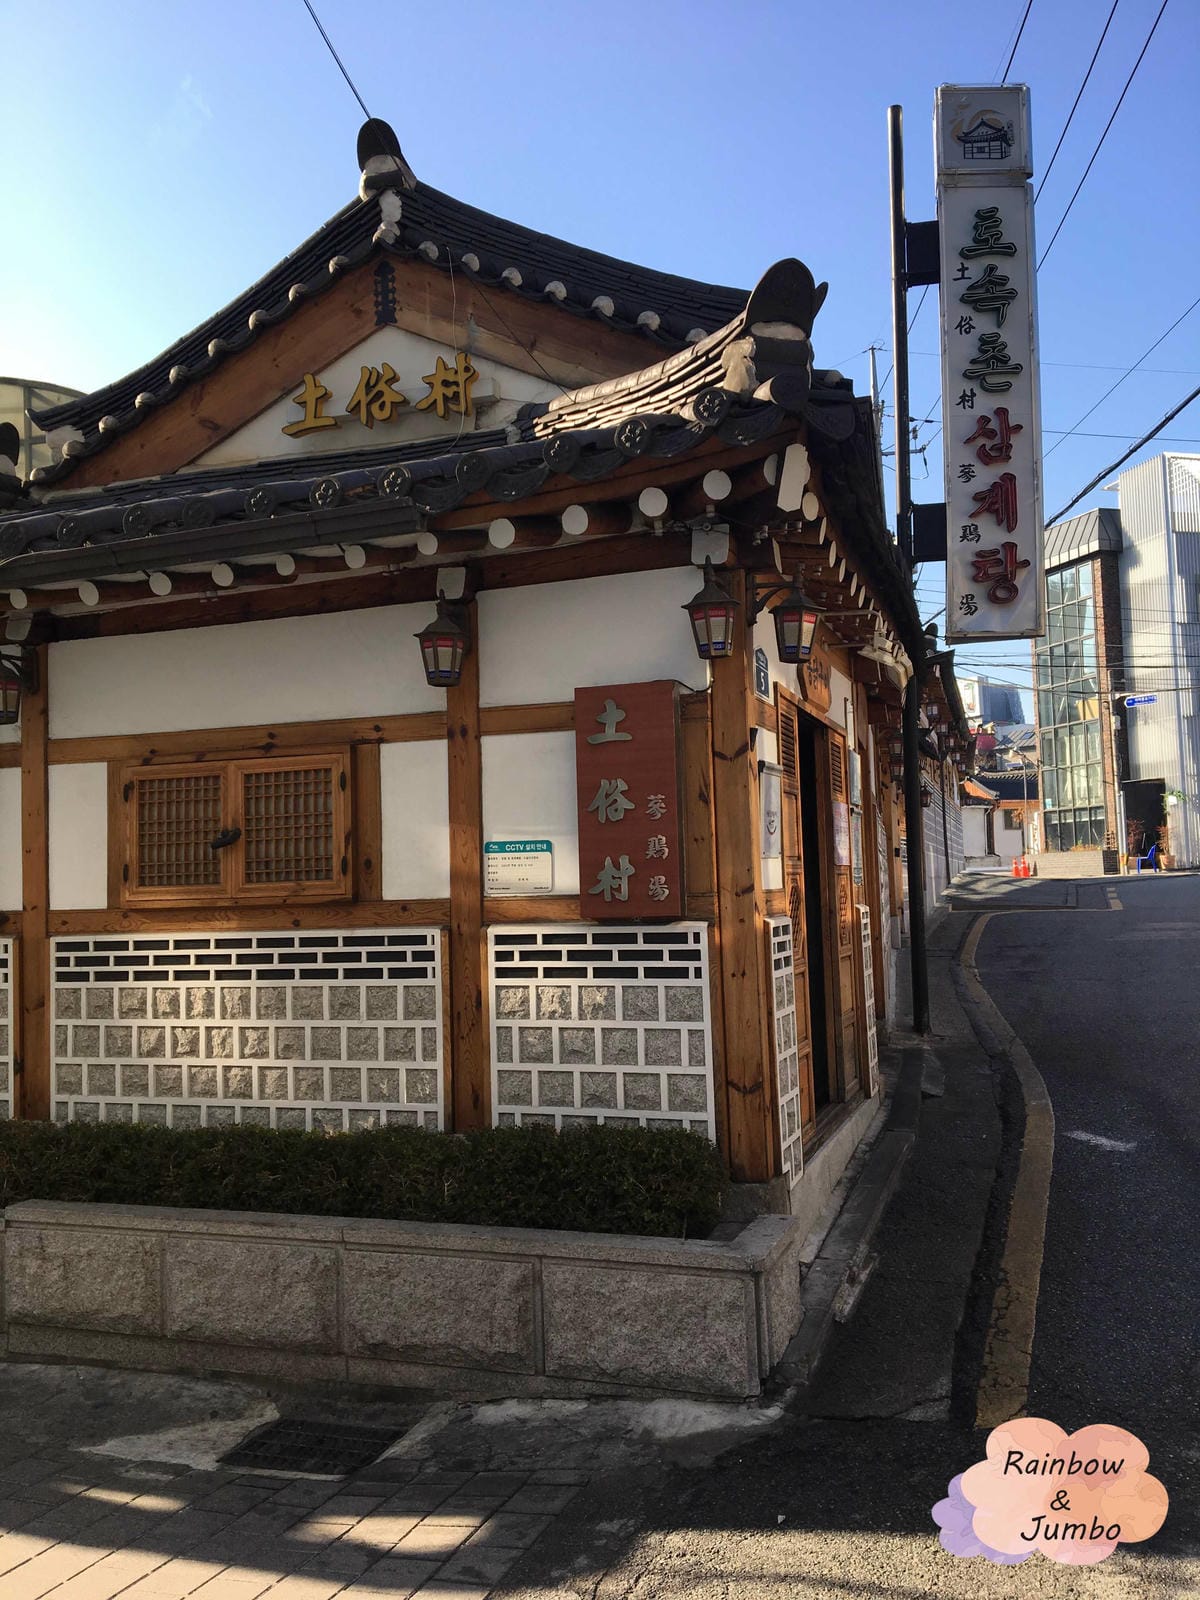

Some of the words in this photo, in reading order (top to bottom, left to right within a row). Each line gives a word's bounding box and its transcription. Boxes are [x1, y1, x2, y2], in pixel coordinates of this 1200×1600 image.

[281, 352, 480, 439] 土俗村
[959, 206, 1023, 393] 토속촌
[963, 406, 1031, 605] 삼계탕
[586, 699, 636, 902] 土俗村
